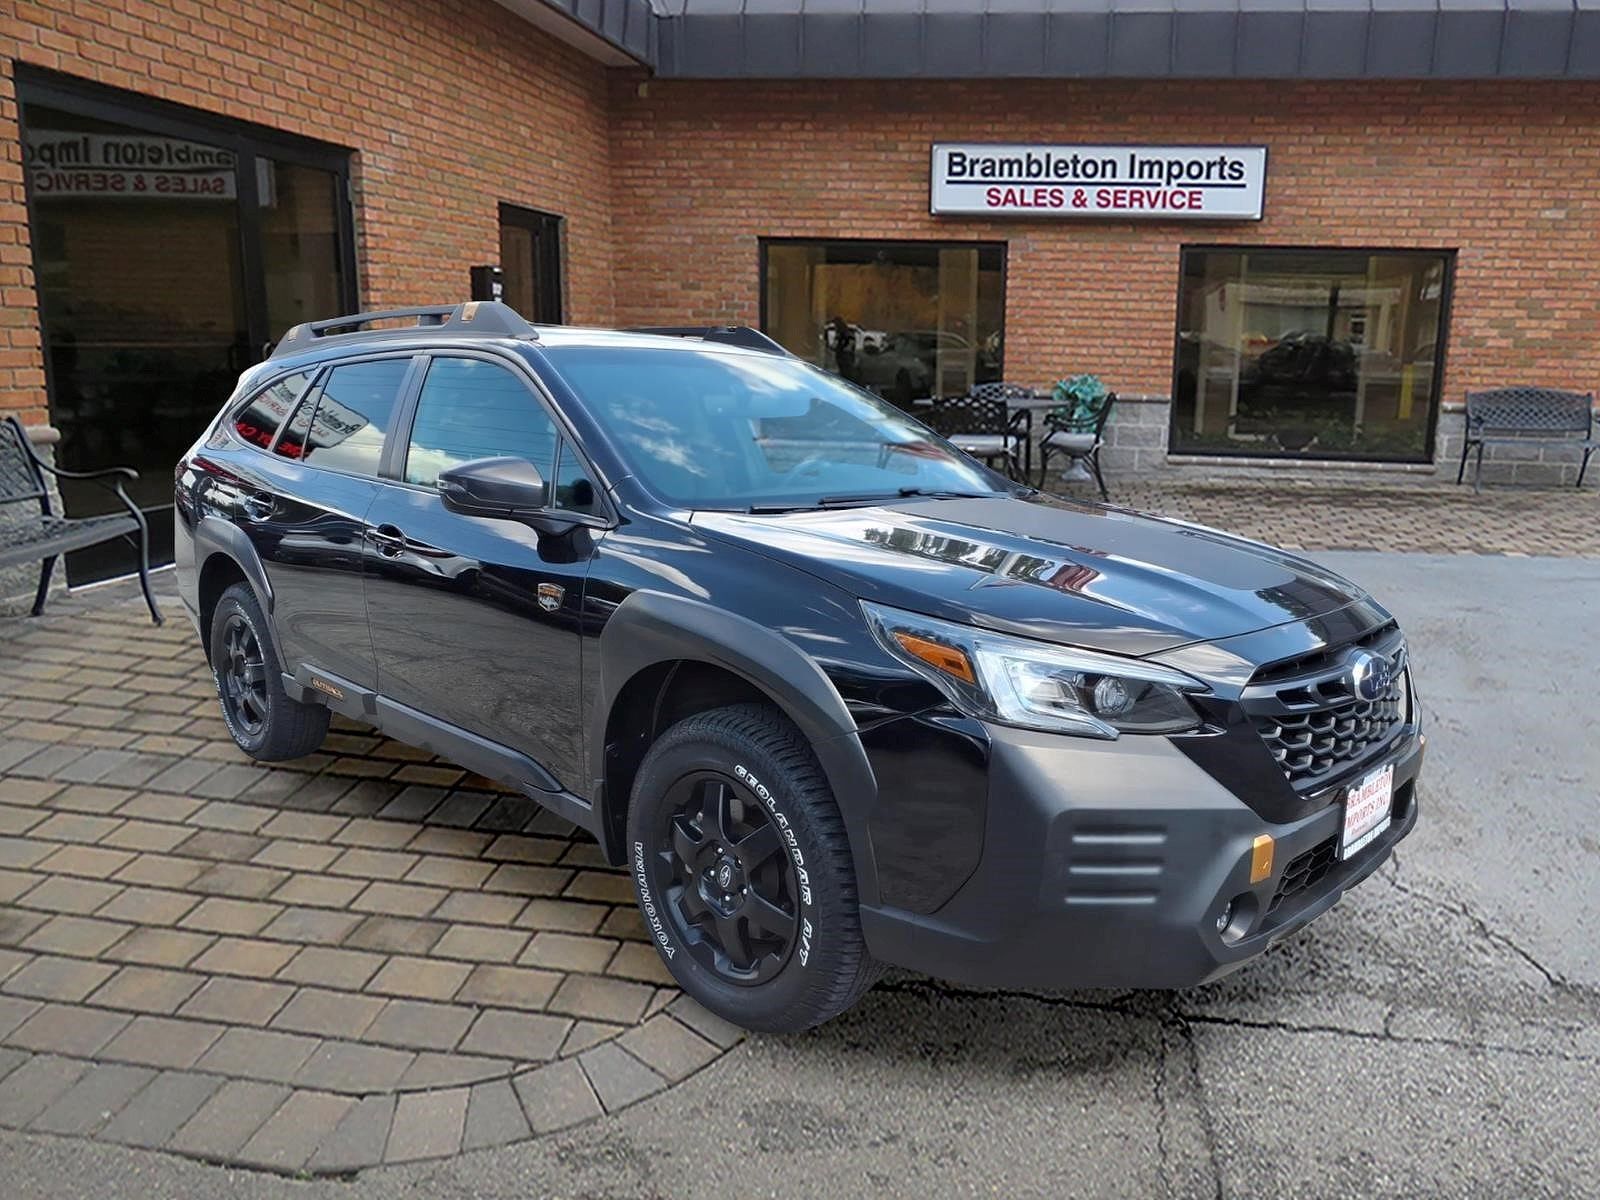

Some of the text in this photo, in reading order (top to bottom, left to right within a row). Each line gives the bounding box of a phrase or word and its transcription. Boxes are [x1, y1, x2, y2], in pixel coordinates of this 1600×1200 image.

[948, 152, 1245, 187] Brambleton Imports
[986, 187, 1203, 209] SALES & SERVICE
[634, 841, 676, 961] YOKOHAMA
[734, 764, 813, 967] GEOLANDAR A/T
